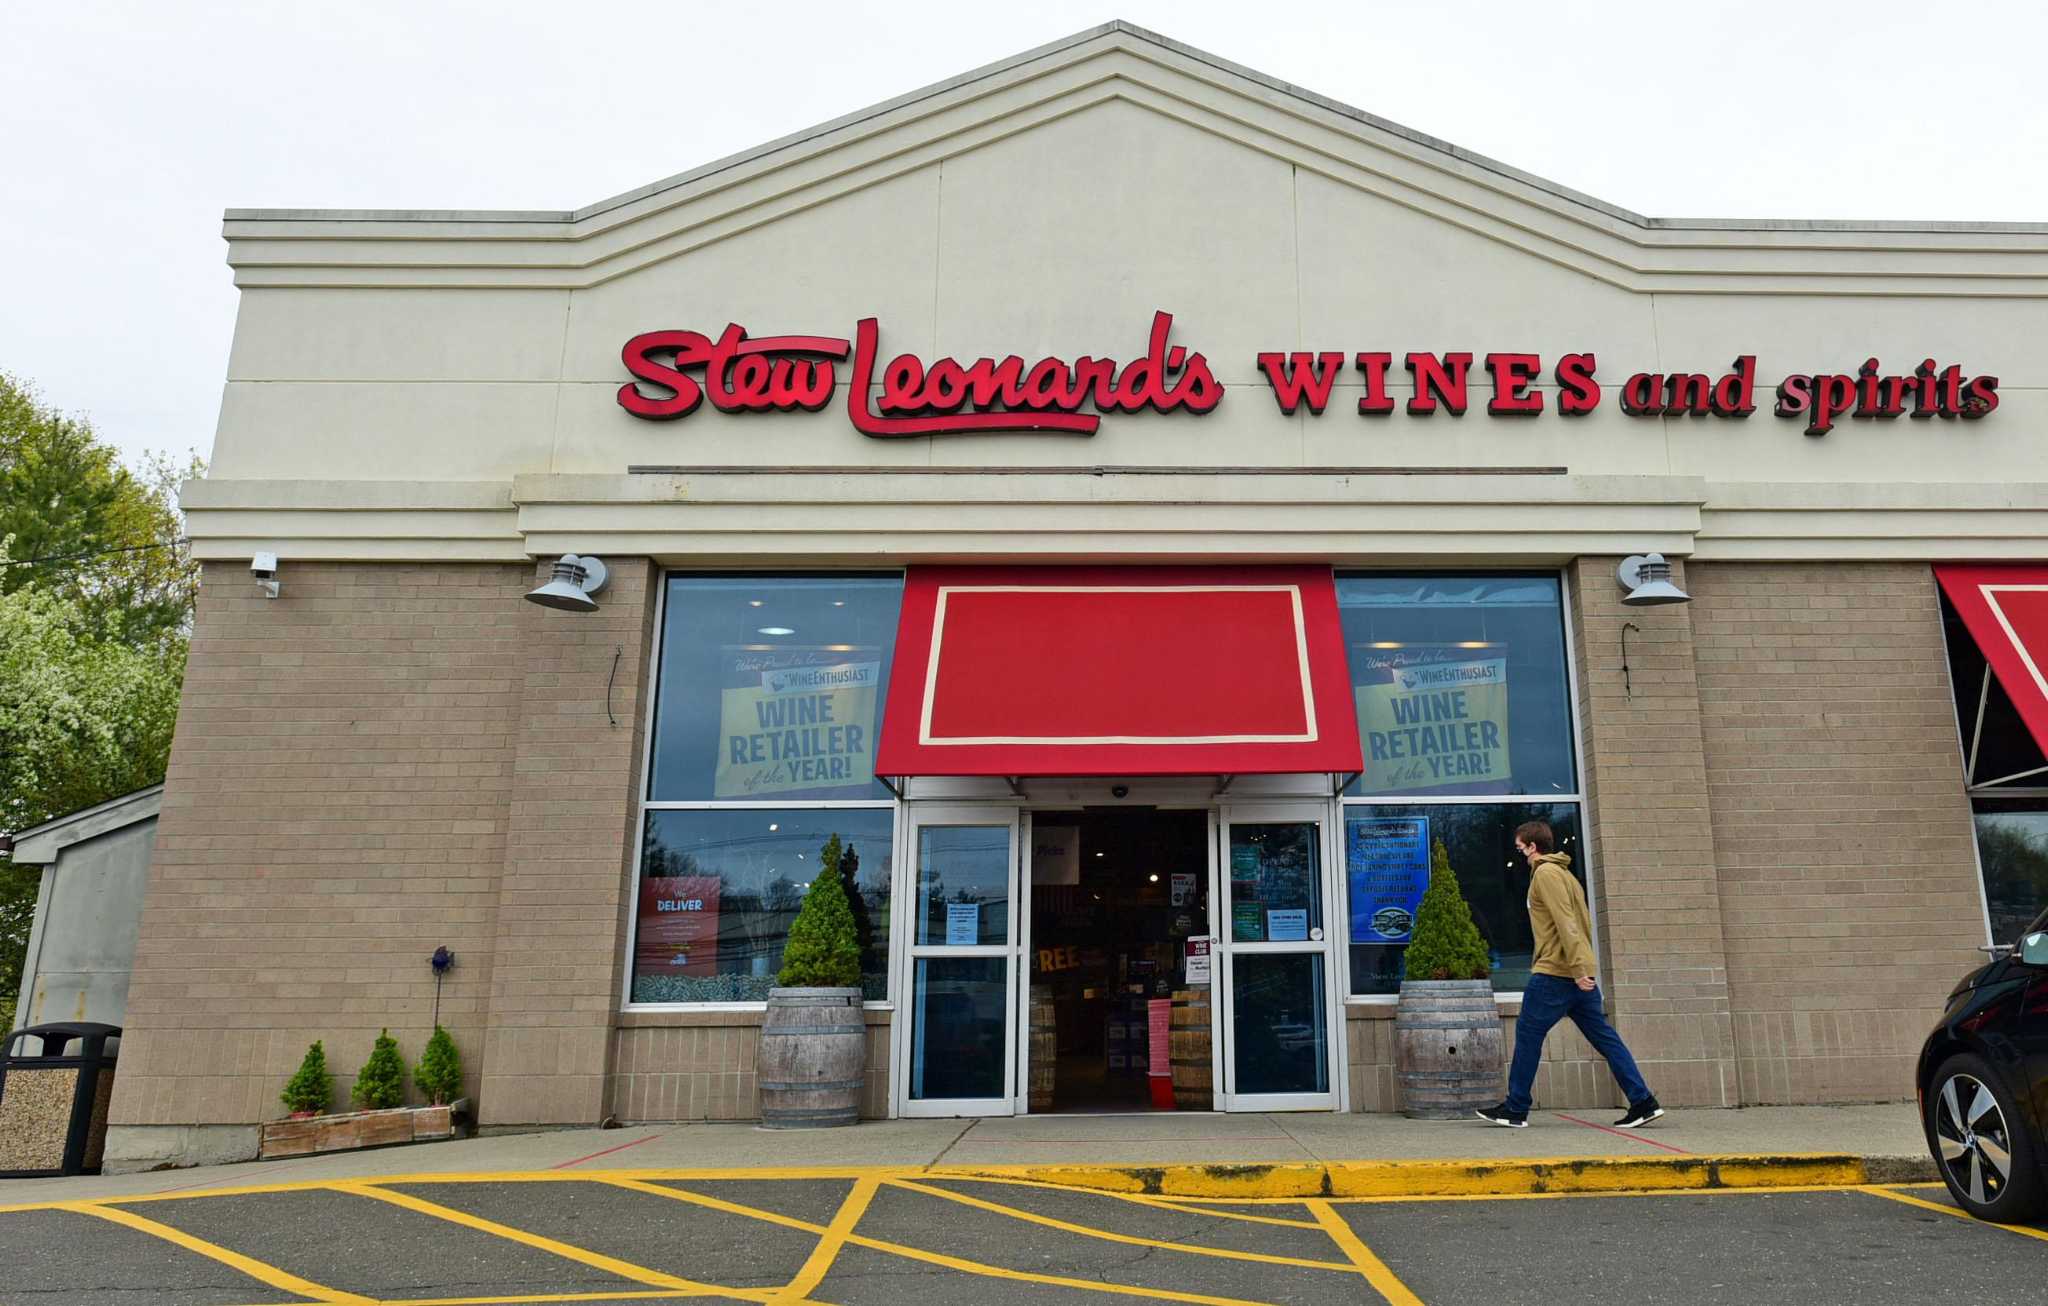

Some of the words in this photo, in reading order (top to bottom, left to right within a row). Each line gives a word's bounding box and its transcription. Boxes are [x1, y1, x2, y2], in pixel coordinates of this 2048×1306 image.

[619, 323, 852, 425] Stew
[848, 310, 1226, 442] Leonard's
[1257, 352, 1602, 420] WINES
[1621, 355, 1758, 422] and
[1775, 357, 2000, 439] spirits
[756, 694, 835, 728] WINE
[1390, 690, 1469, 725] WINE
[729, 724, 865, 765] RETAILER
[1368, 720, 1500, 761] RETAILER
[743, 768, 762, 790] of
[761, 764, 785, 784] the
[787, 756, 853, 783] YEAR!
[1386, 765, 1404, 787] of
[1403, 761, 1425, 781] the
[1427, 751, 1492, 778] YEAR!
[656, 899, 703, 912] DELIVER
